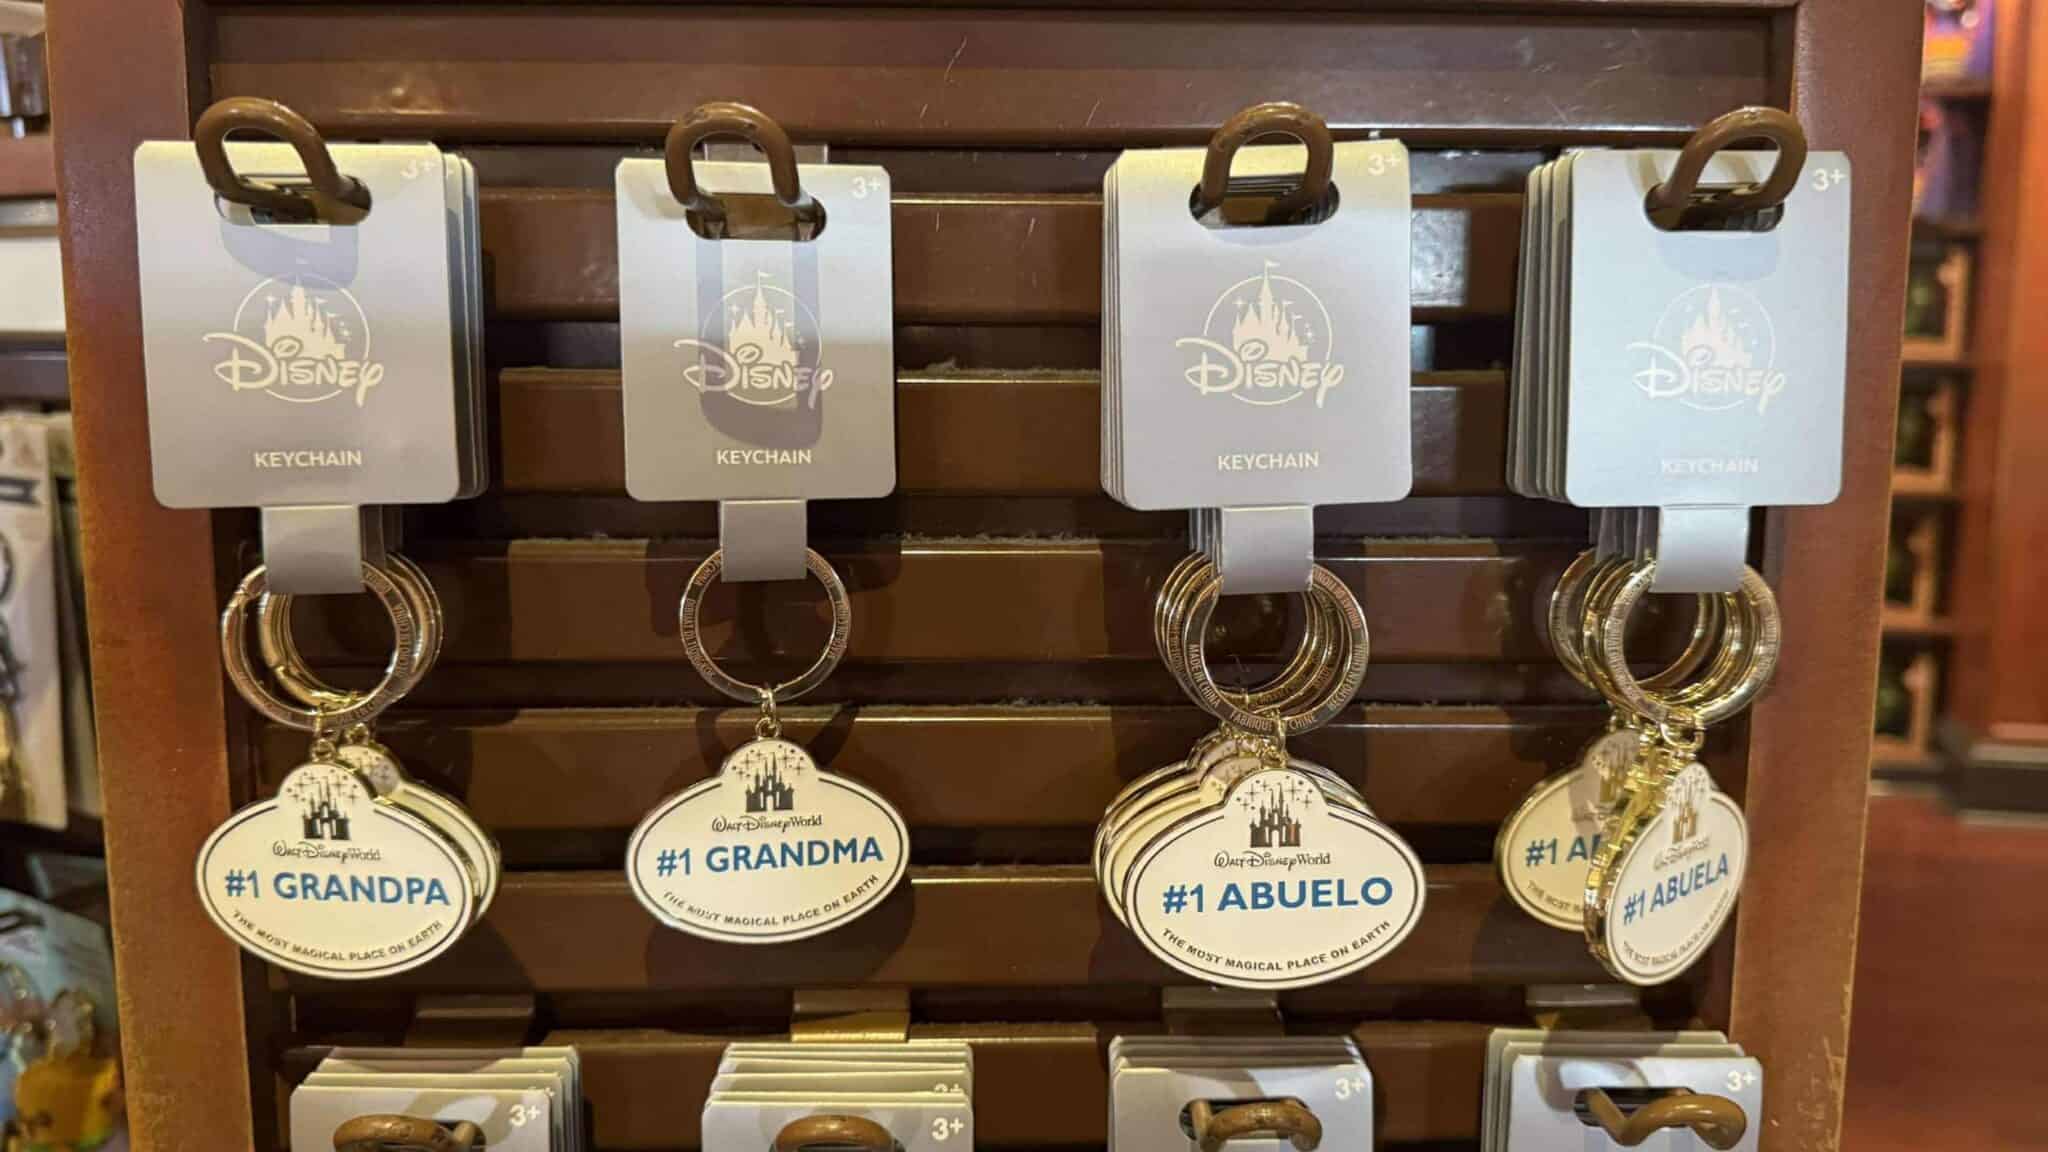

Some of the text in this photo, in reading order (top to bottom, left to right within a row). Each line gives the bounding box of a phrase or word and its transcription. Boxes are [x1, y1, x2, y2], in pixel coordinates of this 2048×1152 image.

[1368, 152, 1400, 176] 3+
[850, 176, 881, 199] 3+
[1811, 168, 1846, 191] 3+
[254, 450, 363, 468] KEYCHAIN
[717, 450, 812, 465] KEYCHAIN
[1217, 451, 1320, 471] KEYCHAIN
[1661, 457, 1759, 474] KEYCHAIN
[790, 814, 823, 827] World
[656, 836, 884, 877] #1 GRANDMA
[1297, 853, 1331, 866] World
[1526, 837, 1557, 868] #1
[225, 869, 450, 905] #1 GRANDPA
[1162, 876, 1393, 914] #1 ABUELO
[1623, 888, 1646, 926] #1
[1650, 852, 1729, 913] ABUELA
[723, 915, 778, 927] MAGICAL
[782, 908, 819, 925] PLACE
[824, 900, 840, 913] ON
[843, 874, 879, 904] EARTH
[233, 910, 443, 962] THE MOST MAGICAL PLACE ON EARTH
[1162, 920, 1391, 971] THE MOST MAGICAL PLACE ON EARTH
[1335, 1077, 1366, 1100] 3+
[1726, 1069, 1757, 1092] 3+
[509, 1104, 541, 1128] 3+
[932, 1117, 964, 1140] 3+
